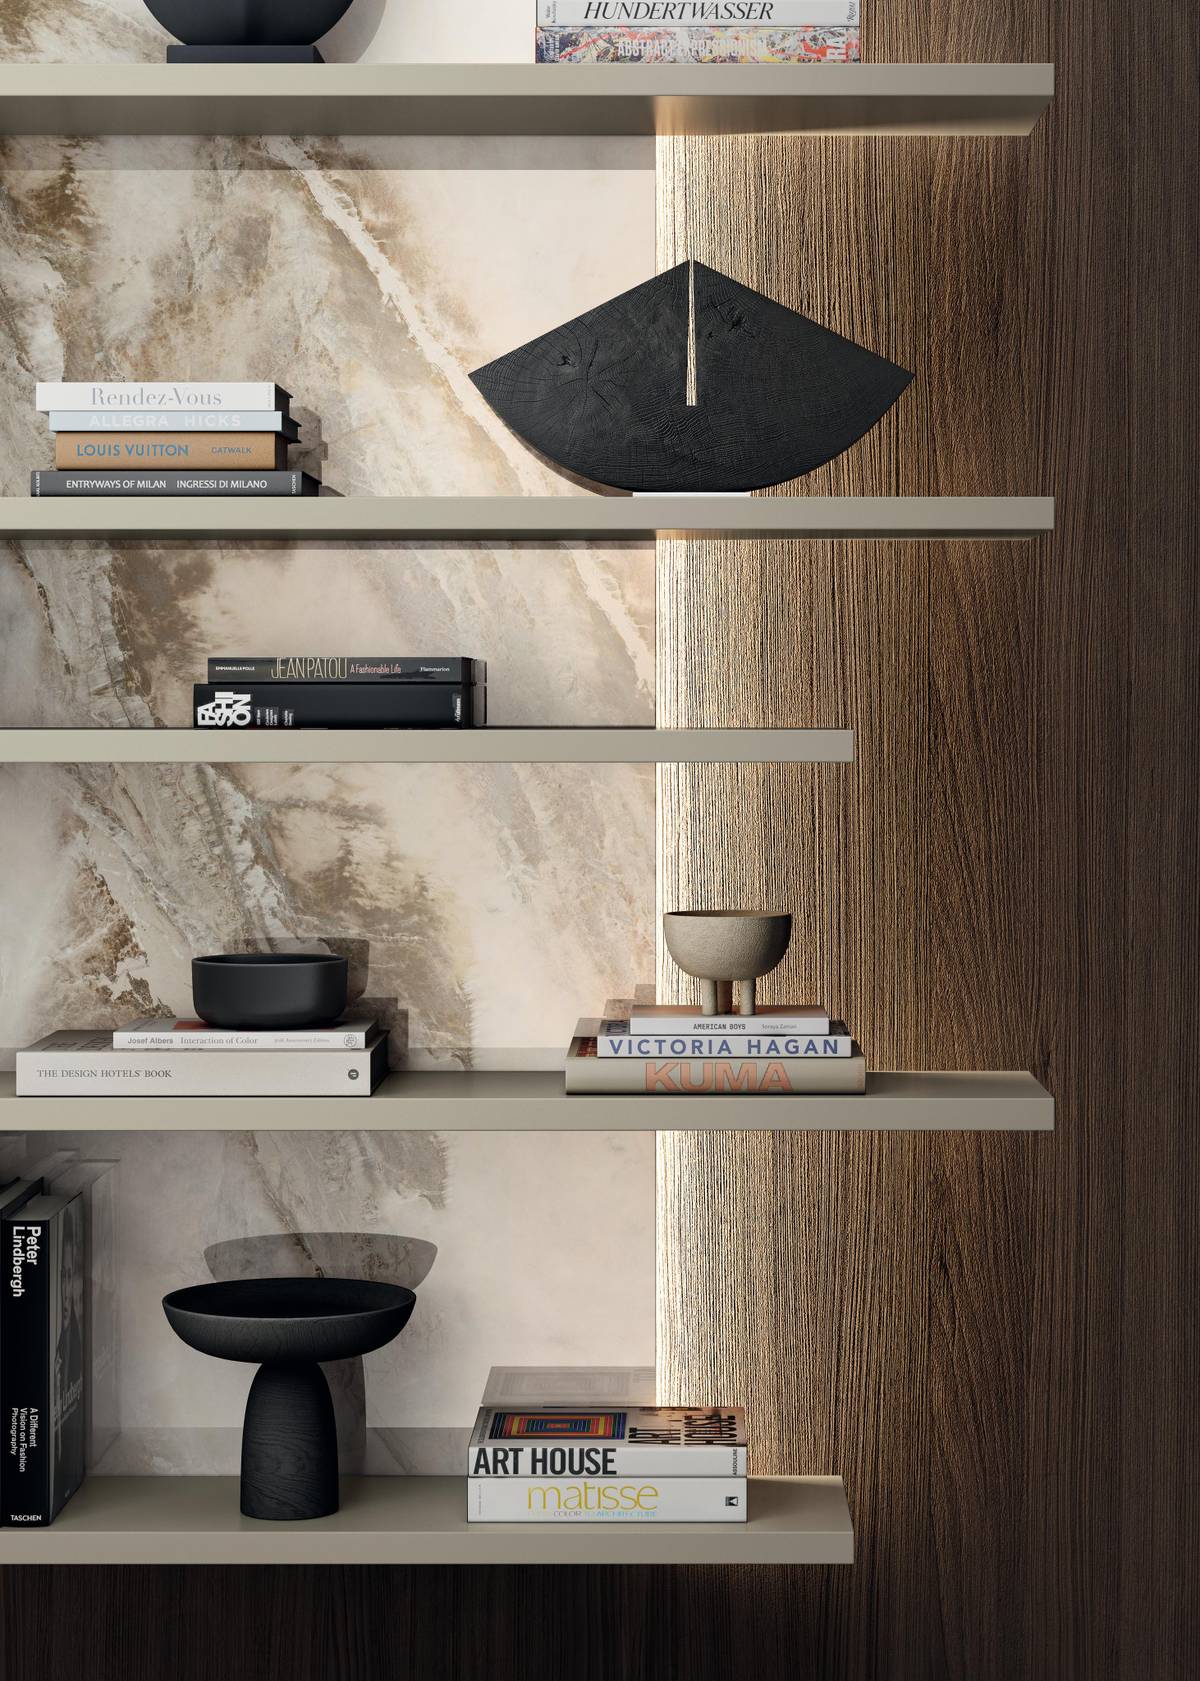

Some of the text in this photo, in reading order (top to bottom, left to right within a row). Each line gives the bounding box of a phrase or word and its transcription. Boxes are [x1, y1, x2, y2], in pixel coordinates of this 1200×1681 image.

[584, 2, 774, 20] HUNDERTWASSER
[92, 387, 221, 405] Rendez-Vous
[89, 415, 241, 427] ALLEGRA HICKS
[77, 444, 189, 457] LOUIS VUITTON
[211, 447, 252, 455] CATWALK
[67, 480, 267, 489] ENTRYWAYS OF MILAN INGRESSI DI MILANO
[271, 657, 348, 679] JEAN PATOU
[350, 663, 402, 674] A Fashionable Life
[127, 1036, 148, 1045] Josef
[149, 1036, 174, 1045] Albers
[181, 1036, 222, 1045] Interaction
[223, 1036, 234, 1045] of
[235, 1036, 258, 1045] Color
[609, 1039, 837, 1055] VICTORIA HAGAN
[37, 1069, 172, 1079] THE DESIGN HOTELS BOOK
[645, 1062, 793, 1092] KUMA
[27, 1227, 41, 1265] Peter
[10, 1226, 25, 1297] Lindbergh
[10, 1408, 18, 1456] Photography
[20, 1433, 26, 1442] on
[29, 1415, 38, 1447] Different
[19, 1443, 27, 1472] Fashion
[473, 1447, 617, 1475] ART HOUSE
[528, 1481, 659, 1511] matisse
[553, 1510, 582, 1518] COLOR
